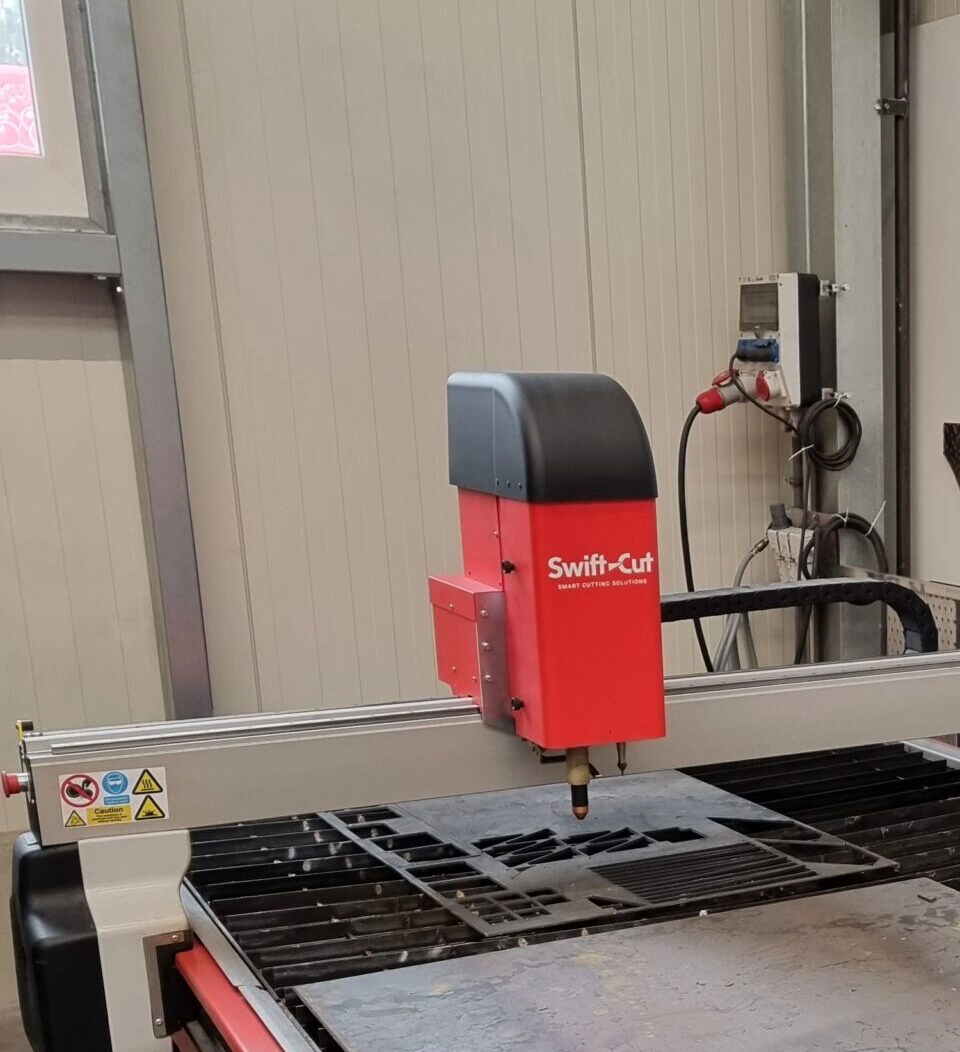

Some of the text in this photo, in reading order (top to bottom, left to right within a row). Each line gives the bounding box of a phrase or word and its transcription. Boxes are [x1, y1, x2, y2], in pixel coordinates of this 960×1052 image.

[548, 552, 654, 579] Swift-Cut
[558, 582, 581, 590] SMART
[612, 578, 648, 586] SOLUTIONS
